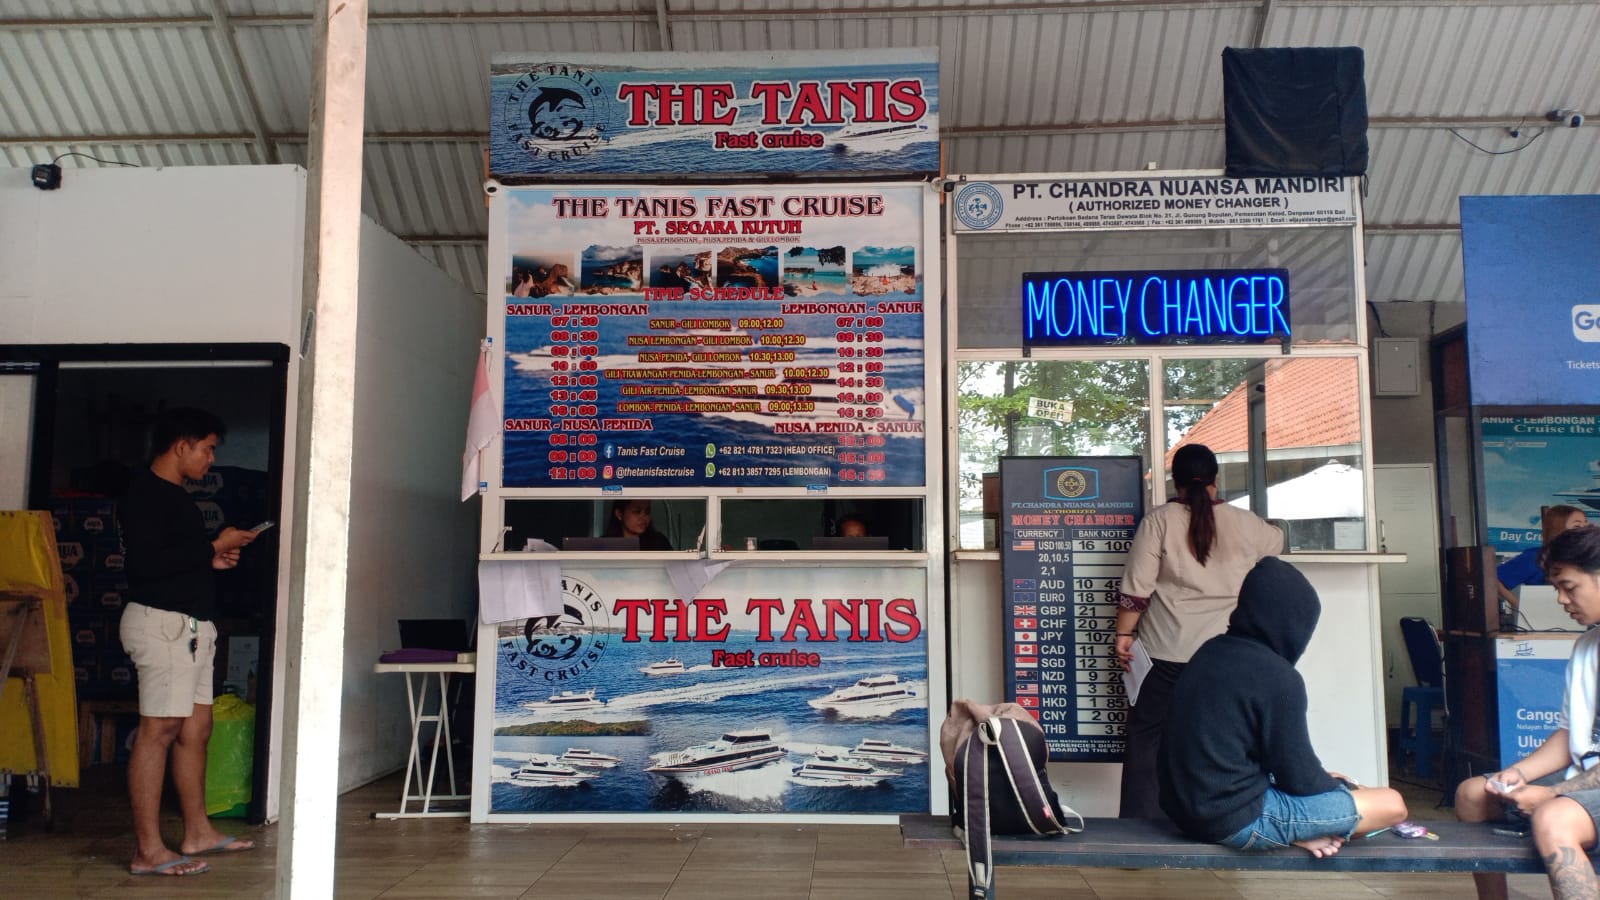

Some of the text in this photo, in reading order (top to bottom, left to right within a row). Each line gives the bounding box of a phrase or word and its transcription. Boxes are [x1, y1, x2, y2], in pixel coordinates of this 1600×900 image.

[509, 65, 602, 102] THE TANIS
[618, 80, 927, 125] THE TANIS
[508, 122, 606, 161] FAST CRUISE
[715, 130, 823, 148] Fast cruise
[1013, 176, 1345, 199] PT. CHANDRA NUANSA MANDIRI
[553, 195, 885, 218] THE TANIS FAST CRUISE
[1076, 197, 1280, 211] AUTHORIZED MONEY CHANGER
[634, 220, 802, 235] PT. SEGARA KUTUH
[643, 287, 785, 301] TIME SCHEDULE
[506, 304, 649, 315] SANUR LEMBONGAN
[781, 302, 923, 314] LEMBONGAN SANUR
[1027, 276, 1291, 339] MONEY CHANGER
[649, 318, 784, 329] SANUR GILI LOMBOK 09.00,12.00
[628, 335, 806, 346] NUSA LEMBONGAN GILI LOMBOK 10.00,12.30
[639, 353, 659, 362] NUSA
[708, 352, 741, 362] LOMBOK
[749, 351, 796, 362] 10.30,13.00
[750, 368, 776, 378] SANUR
[783, 367, 830, 378] 10.00,12.30
[765, 384, 811, 395] 09.30,13.00
[768, 401, 814, 412] 09.00,13.30
[1036, 400, 1065, 410] BUKA
[505, 419, 653, 431] SANUR NUSA PENIDA
[774, 421, 923, 433] NUSA PENIDA SANUR
[1513, 424, 1594, 433] Cruise the
[617, 446, 686, 456] Tanis Fast Cruise
[719, 446, 732, 455] +62
[733, 446, 745, 455] 821
[747, 446, 764, 455] 4781
[766, 446, 782, 455] 7323
[616, 466, 695, 479] @thetanisfastcruise
[718, 467, 731, 476] +62
[732, 467, 745, 476] 813
[746, 467, 763, 476] 3857
[765, 467, 781, 476] 7295
[782, 467, 831, 477] (LEMBONGAN)
[1011, 514, 1135, 526] MONEY CHANGER
[1017, 530, 1129, 538] CURRENCY BANK NOTE
[1500, 531, 1522, 542] Day
[1078, 540, 1095, 551] 16
[1039, 579, 1093, 589] AUD 10
[561, 579, 602, 611] ANIS
[1039, 592, 1095, 603] EURO 18
[1040, 605, 1096, 617] GBP 21
[613, 598, 922, 643] THE TANIS
[1040, 619, 1098, 629] CHF 20
[1040, 631, 1063, 641] JPY
[1040, 645, 1095, 656] CAD 11
[503, 640, 605, 681] FAST CRUISE
[712, 648, 821, 667] Fast cruise
[1041, 658, 1097, 668] SGD 12
[1041, 671, 1065, 681] NZD
[1042, 685, 1067, 694] MYR
[1042, 698, 1067, 708] HKD
[1043, 711, 1067, 721] CNY
[1044, 724, 1067, 734] THB
